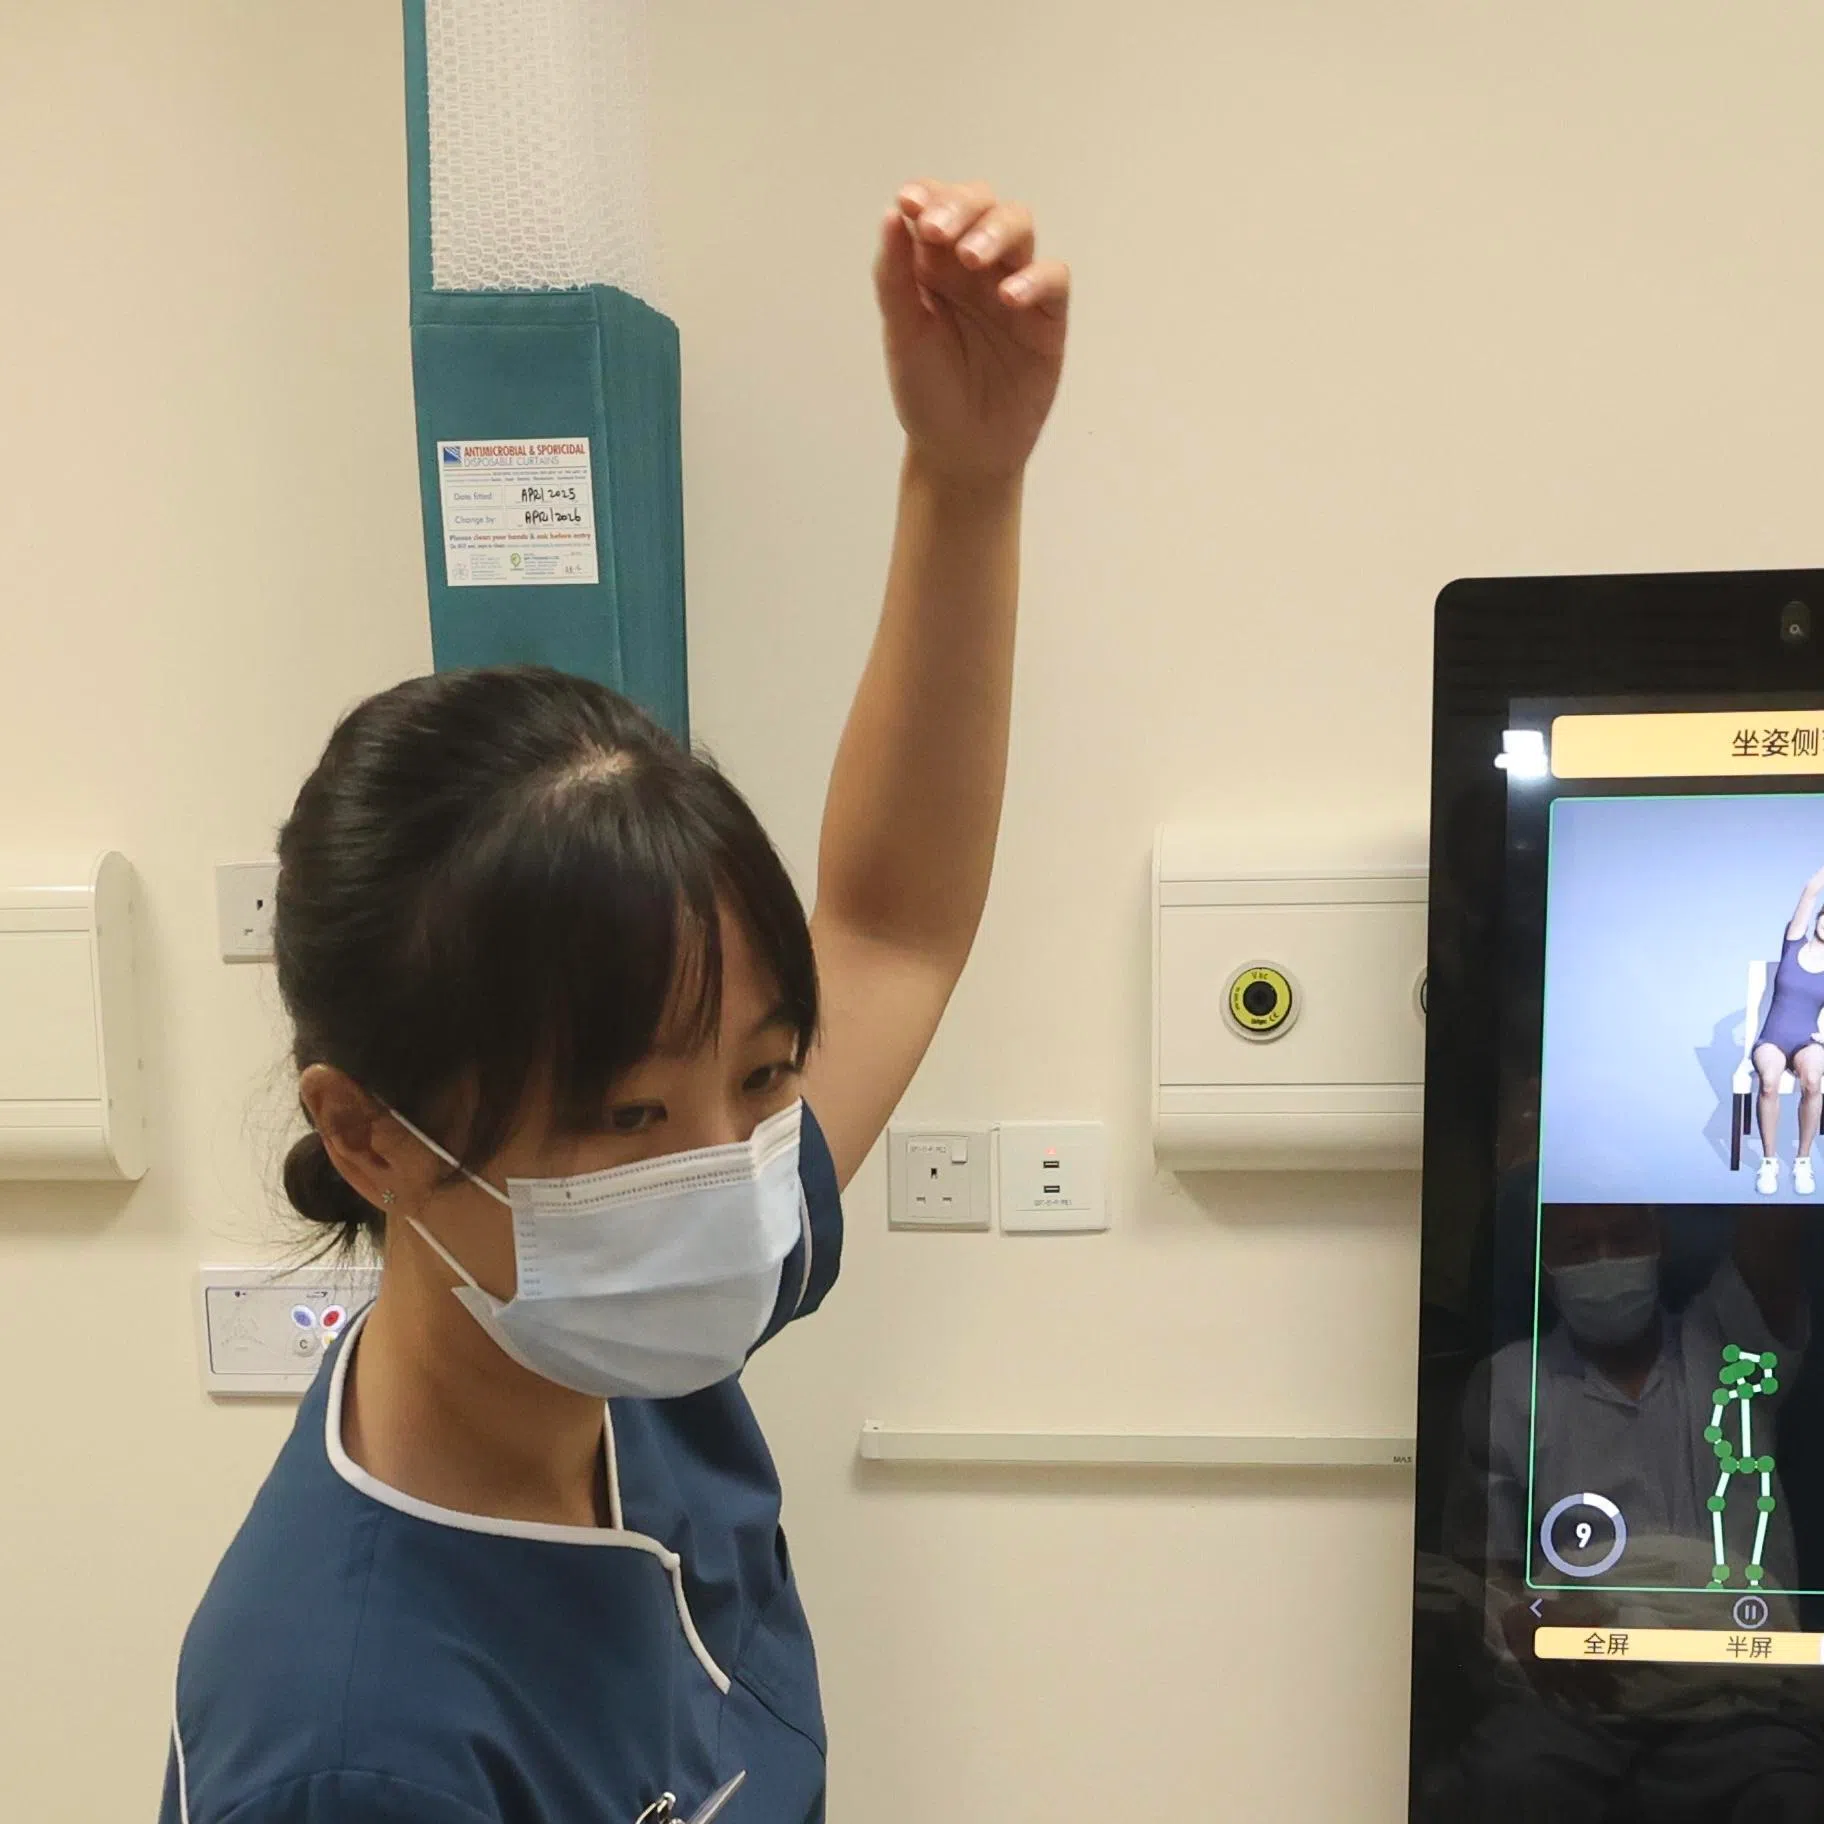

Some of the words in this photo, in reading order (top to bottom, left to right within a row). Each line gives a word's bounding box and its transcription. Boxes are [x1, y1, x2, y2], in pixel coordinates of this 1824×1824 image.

[464, 445, 526, 457] ANTIMICROBIAL
[529, 446, 535, 456] &
[537, 444, 586, 456] SPORICIDAL
[464, 457, 514, 467] DISPOSABLE
[517, 456, 560, 466] CURTAINS
[1575, 1522, 1592, 1549] 9
[1583, 1633, 1630, 1656] 全屏
[1726, 1635, 1772, 1659] 半屏
